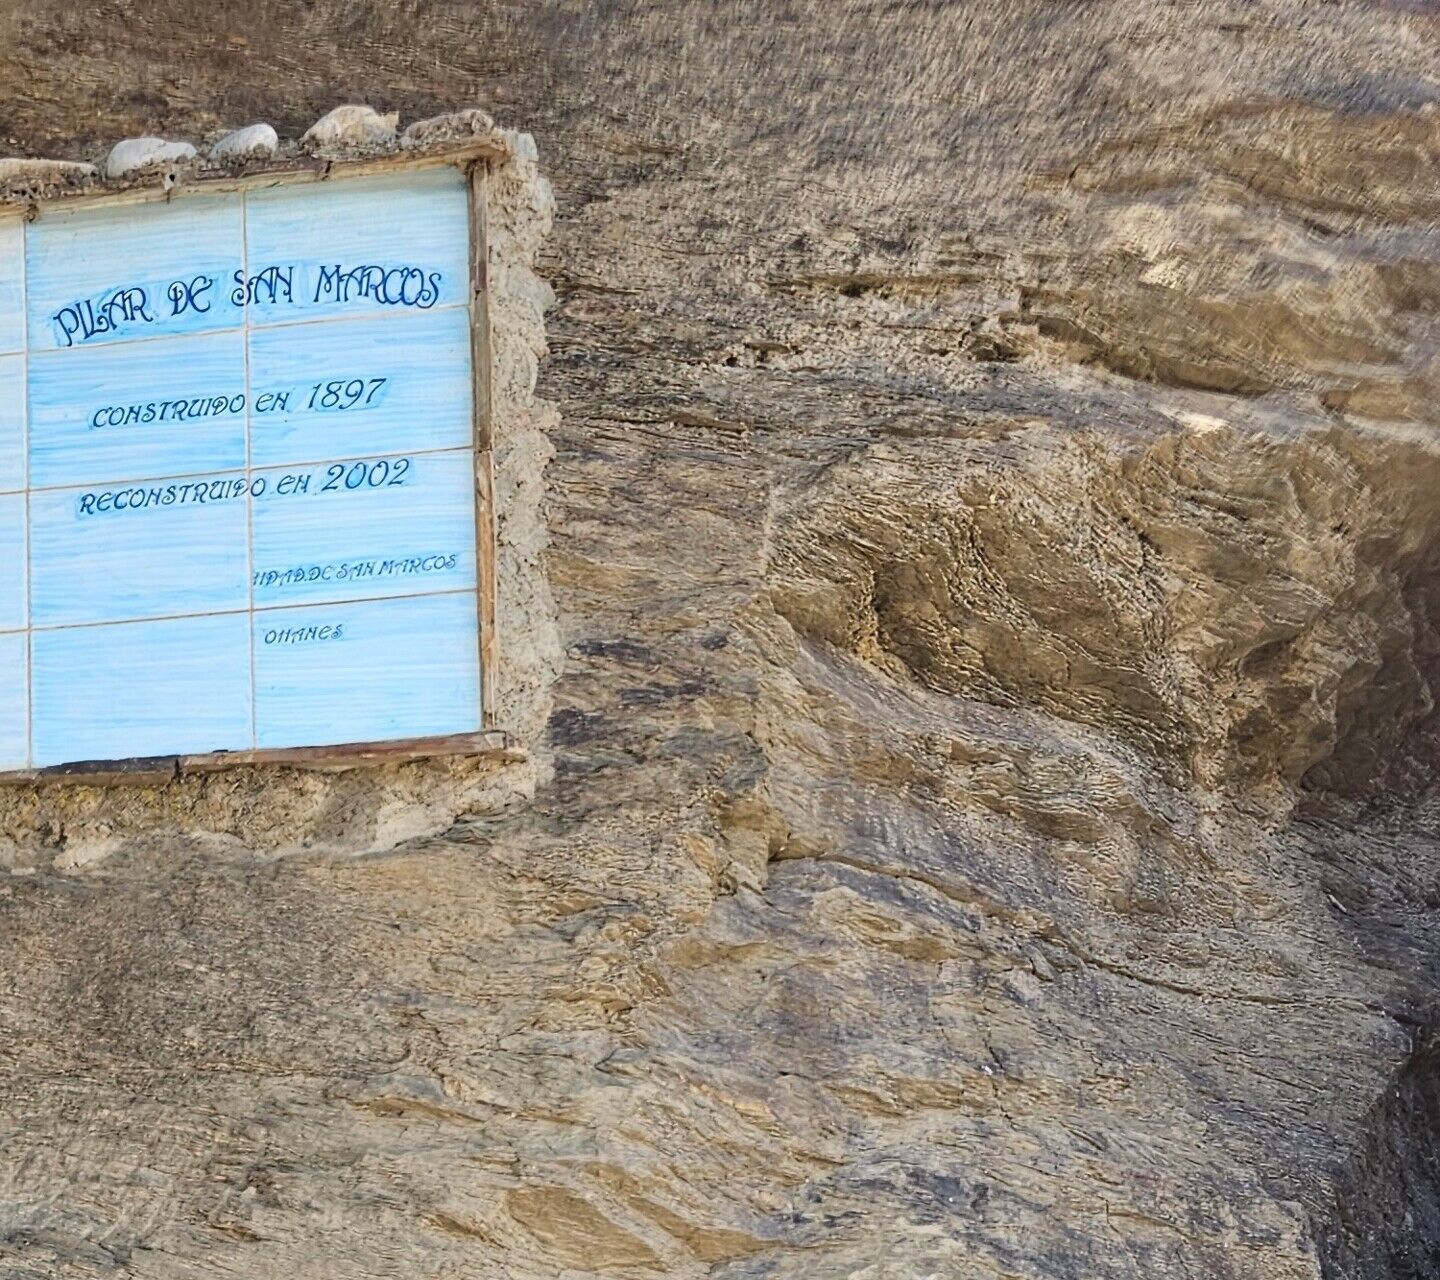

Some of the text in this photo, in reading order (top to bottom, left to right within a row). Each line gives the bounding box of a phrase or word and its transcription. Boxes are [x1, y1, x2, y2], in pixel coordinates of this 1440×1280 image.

[53, 265, 442, 347] PILAR DE SAN MARCOS
[92, 393, 247, 429] CONSTRUIDO
[307, 378, 387, 410] 1897
[79, 476, 267, 515] RECONSTRUIDO
[321, 458, 410, 492] 2002
[335, 561, 376, 580] SAN
[377, 553, 457, 576] MARCOS
